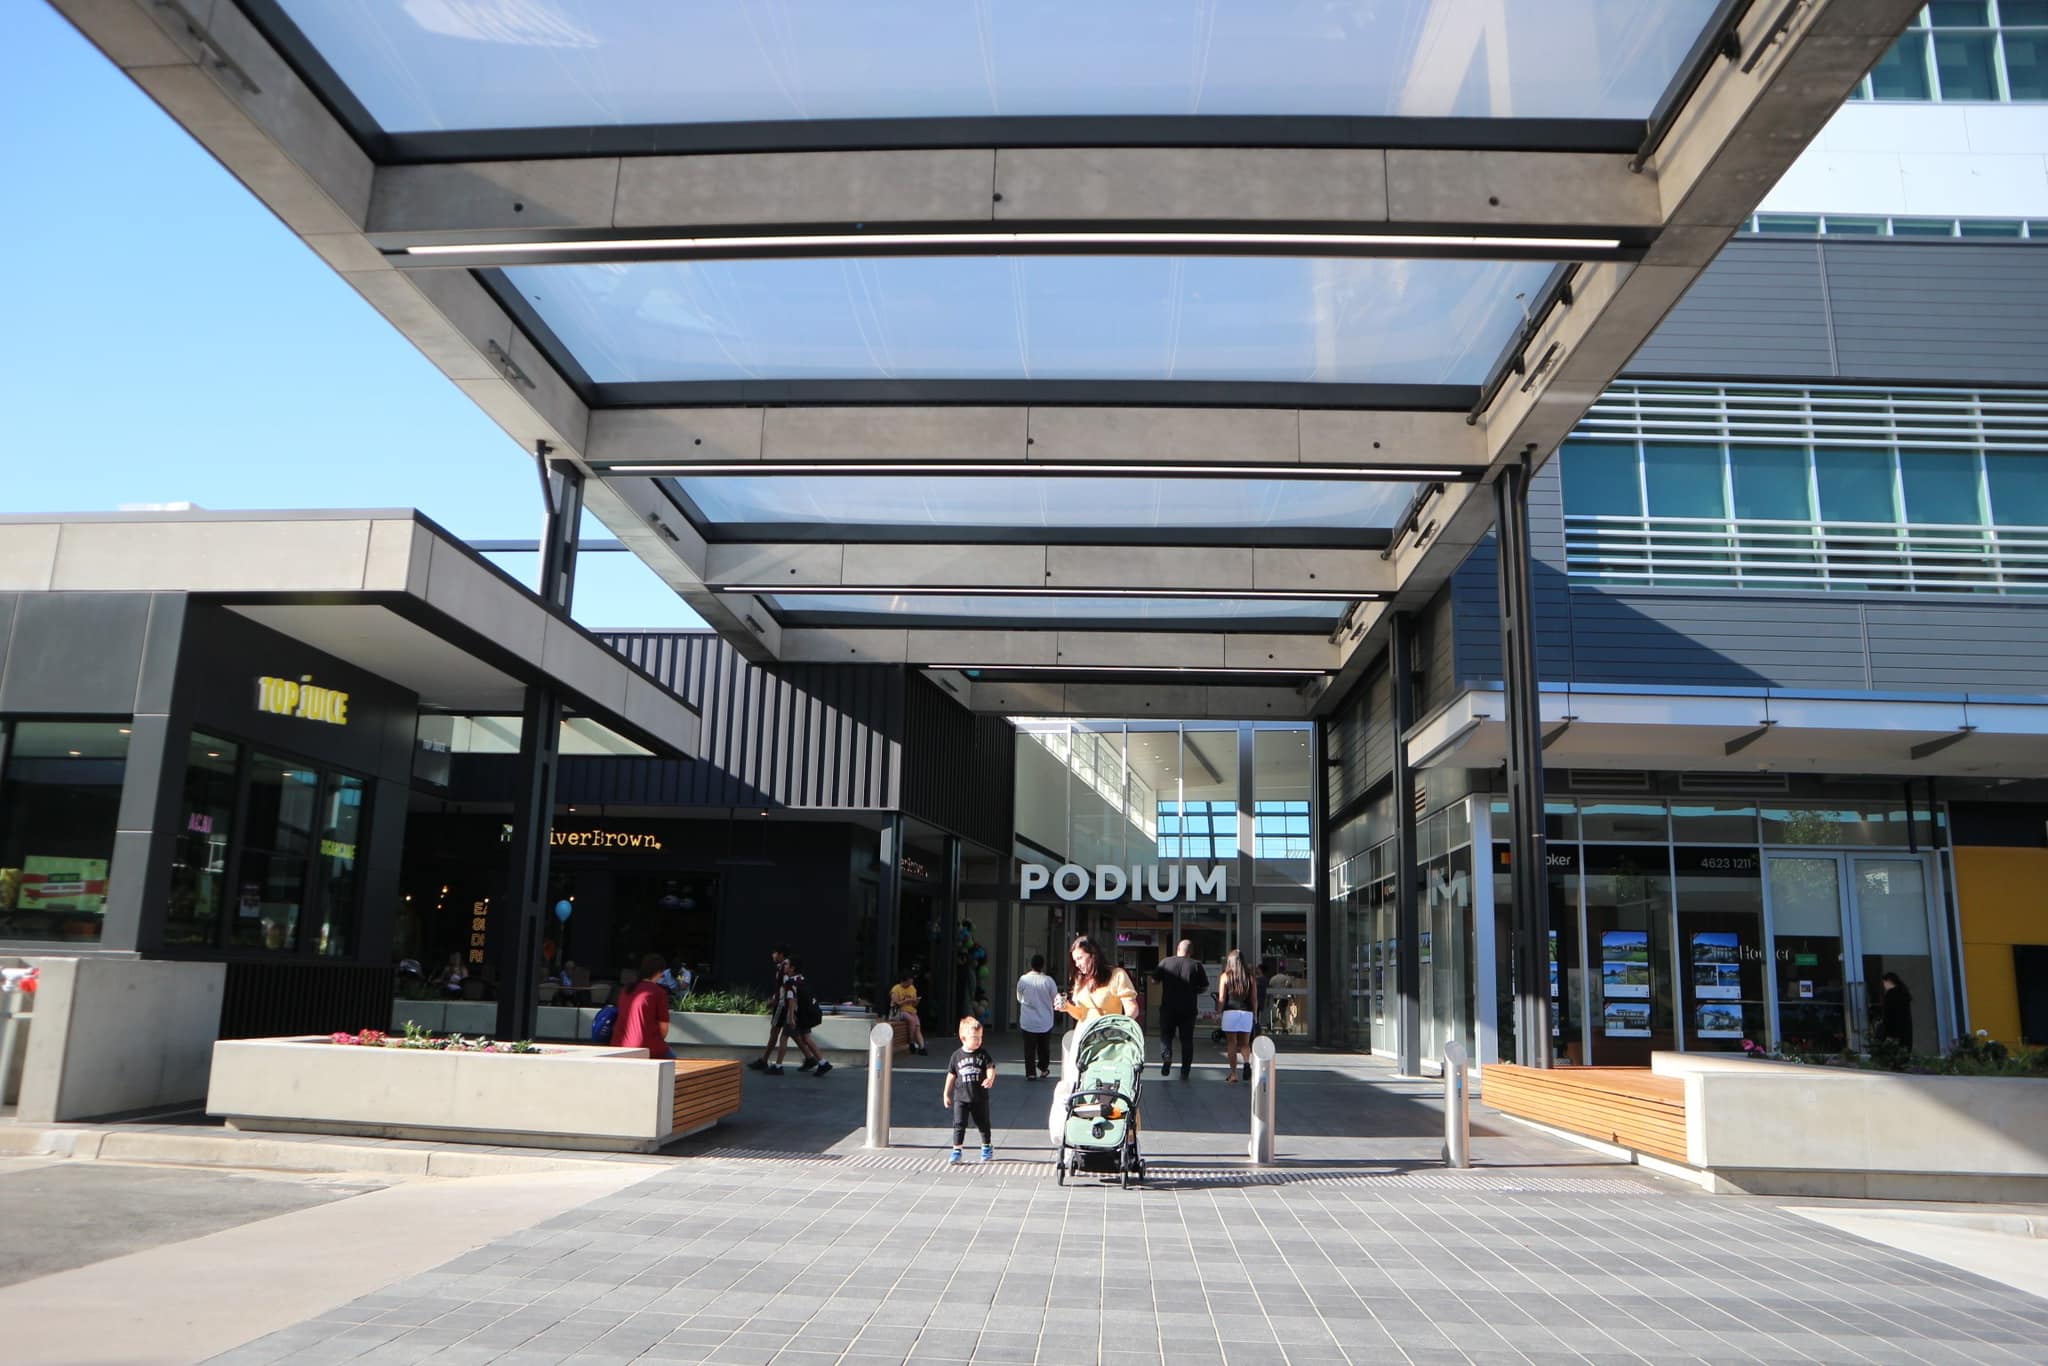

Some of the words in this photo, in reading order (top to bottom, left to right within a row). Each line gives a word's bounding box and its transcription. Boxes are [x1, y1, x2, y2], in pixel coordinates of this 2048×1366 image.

[258, 676, 299, 715] TOP
[296, 674, 349, 725] JUICE
[550, 827, 657, 847] iverBrown
[1545, 853, 1571, 866] oker
[1020, 863, 1227, 902] PODIUM
